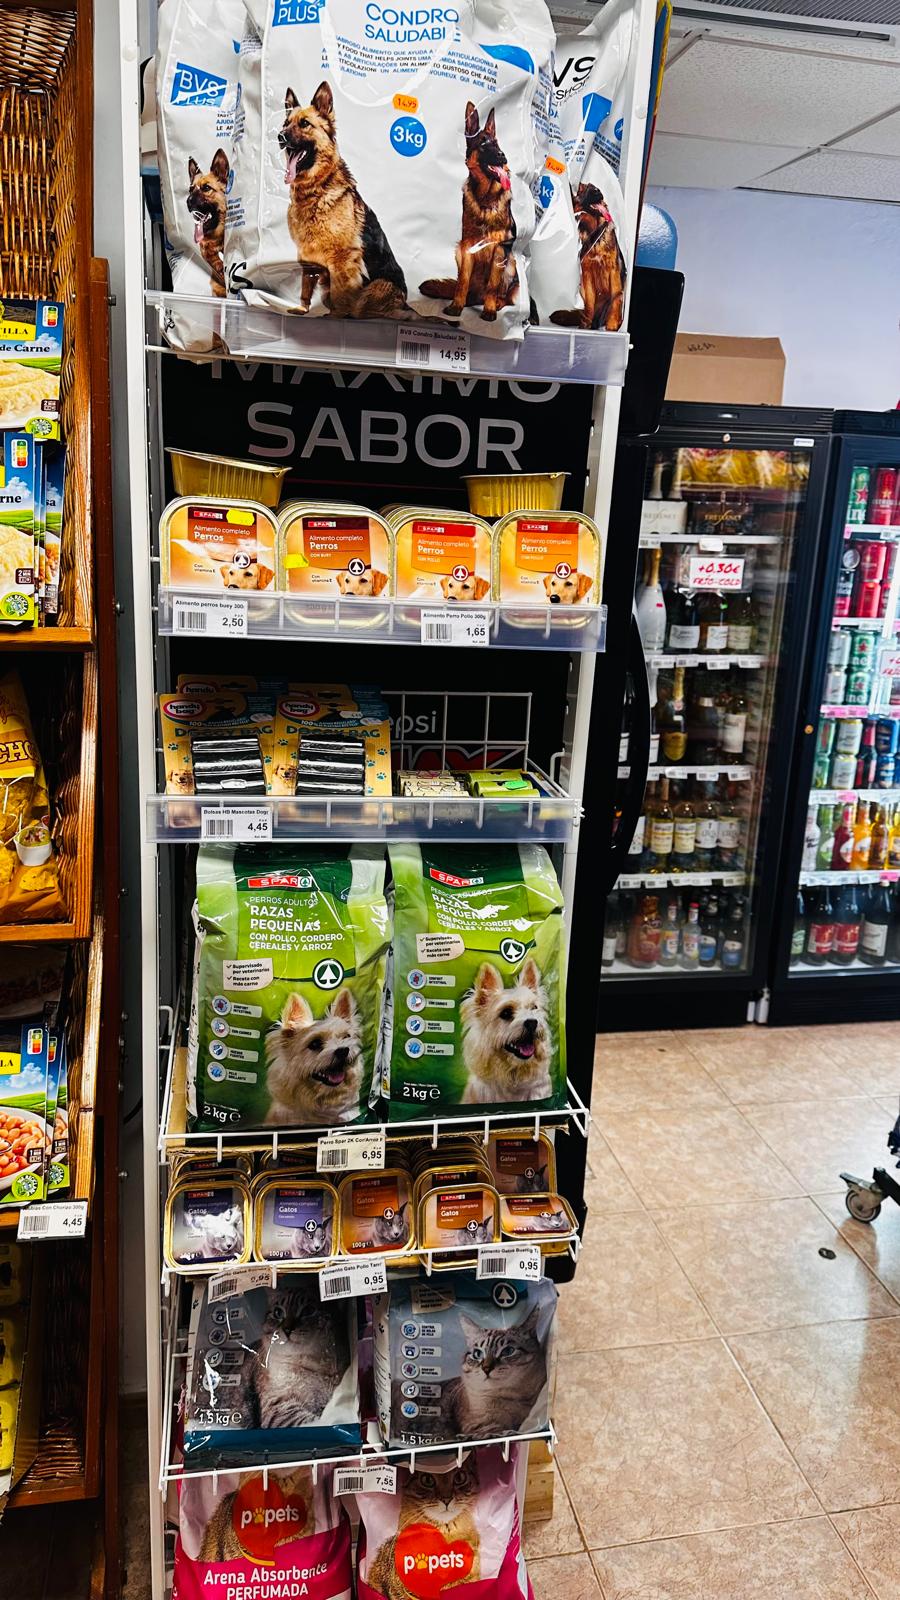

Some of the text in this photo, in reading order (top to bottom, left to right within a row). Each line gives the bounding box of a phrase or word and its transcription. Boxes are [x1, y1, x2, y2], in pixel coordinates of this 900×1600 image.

[277, 7, 318, 24] PLUS
[366, 3, 459, 26] CONDRO
[342, 44, 358, 55] FOOD
[360, 52, 374, 60] THAT
[362, 46, 392, 56] ALIMENTO
[442, 64, 470, 75] GUSTOSO
[393, 125, 424, 148] 3kg
[412, 330, 433, 338] Condro
[14, 344, 51, 353] Carne
[440, 349, 467, 362] 14,95
[247, 401, 525, 471] SABOR
[194, 525, 251, 536] Alimento completo
[194, 532, 224, 541] Perros
[521, 537, 546, 545] Alimento
[309, 542, 339, 550] Perros
[417, 539, 443, 547] Alimento
[521, 543, 548, 553] Perros
[417, 544, 445, 554] Perros
[222, 617, 244, 628] 2,50
[465, 627, 486, 637] 1,65
[247, 822, 268, 832] 4,45
[260, 876, 299, 887] SPAR
[438, 873, 471, 887] SPAR
[250, 896, 282, 905] PERROS
[432, 893, 469, 910] RAZAS
[250, 906, 294, 918] RAZAS
[250, 918, 321, 932] PEQUEÑAS
[437, 919, 477, 931] CEREALES
[250, 933, 266, 942] CON
[300, 933, 345, 943] CORDERO,
[249, 942, 292, 951] CEREALES
[301, 942, 333, 951] ARROZ
[241, 967, 270, 975] veterinarios
[403, 1086, 428, 1100] 2 kg
[203, 1105, 212, 1116] 2
[213, 1105, 228, 1123] kg
[362, 1150, 382, 1161] 6,95
[62, 1217, 83, 1227] 4,45
[519, 1260, 539, 1271] 0,95
[321, 1268, 344, 1276] Alimento
[364, 1275, 384, 1286] 0,95
[198, 1413, 230, 1426] 1,5 kg
[400, 1434, 417, 1445] 1,5
[376, 1477, 394, 1487] 7,55
[203, 1561, 329, 1585] Arena Absorbente
[226, 1583, 309, 1600] PERFUMADA
